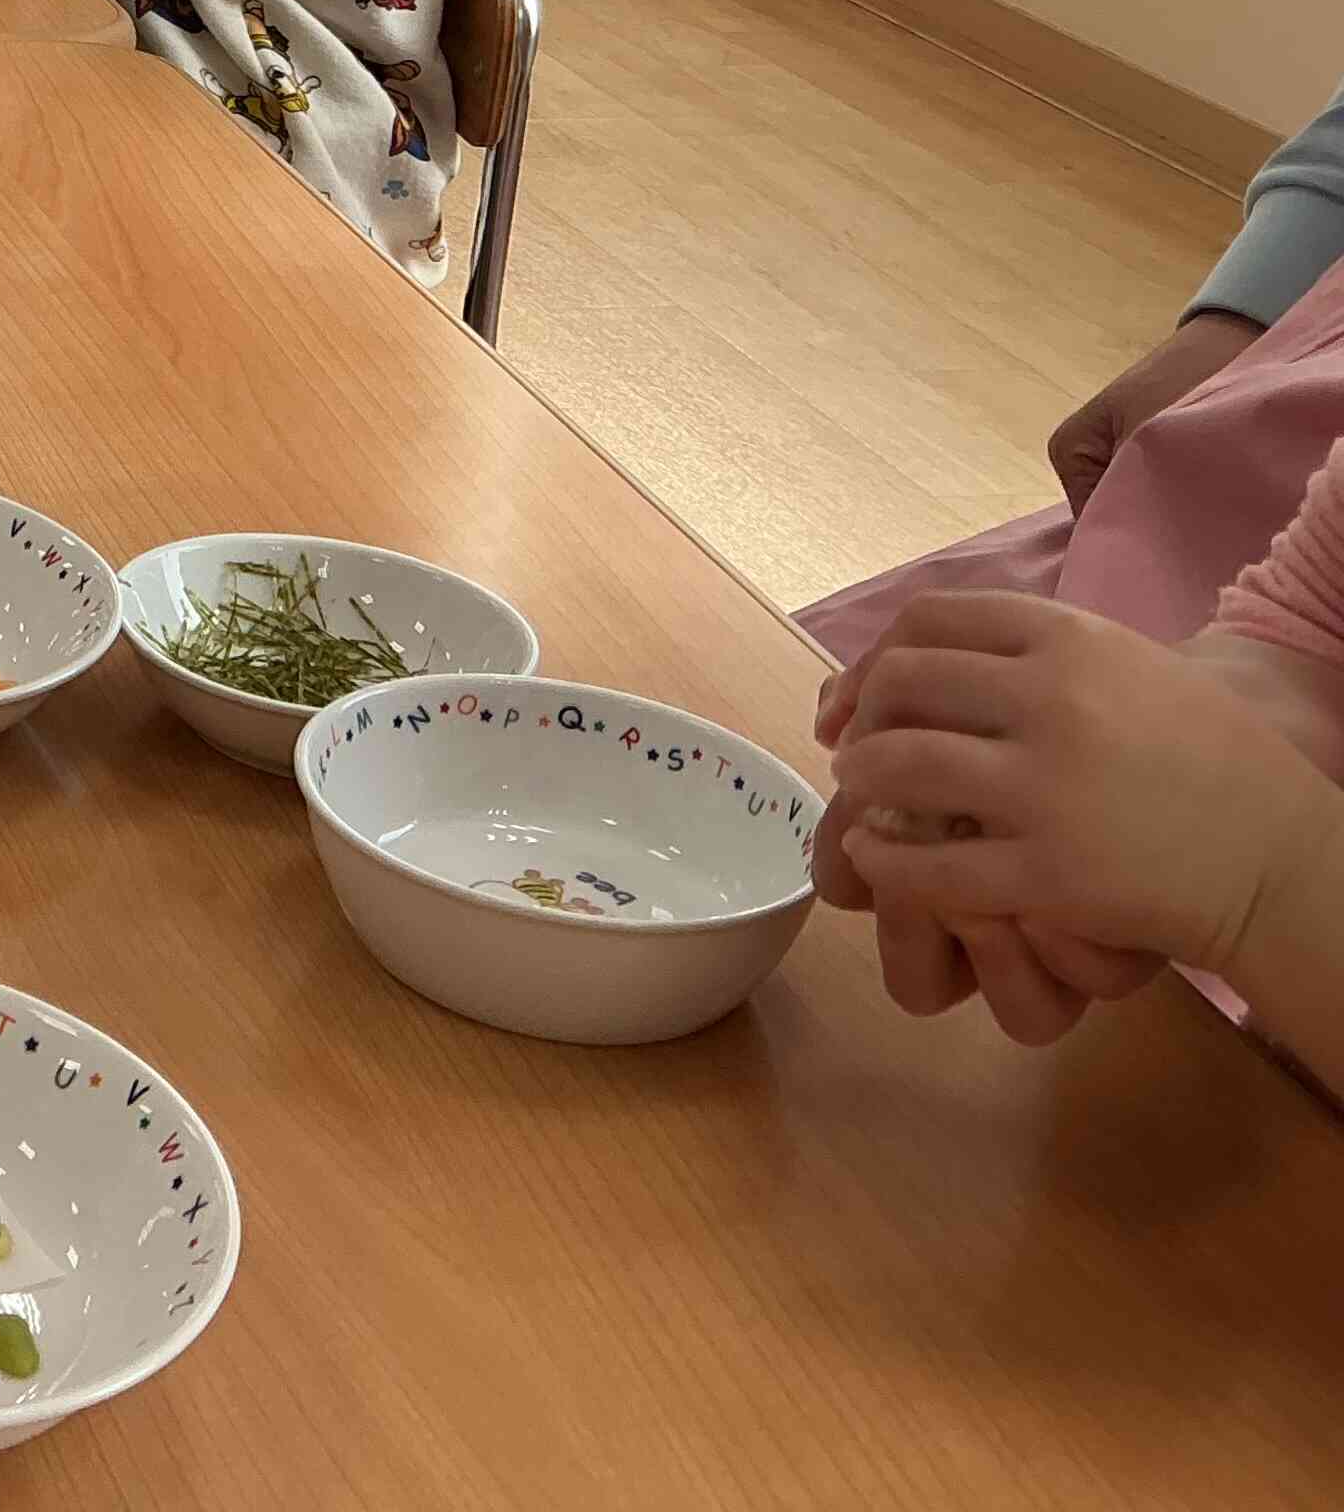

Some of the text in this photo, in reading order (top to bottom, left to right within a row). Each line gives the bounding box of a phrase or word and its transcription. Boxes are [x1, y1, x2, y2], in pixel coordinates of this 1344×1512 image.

[11, 518, 27, 538] V
[41, 545, 62, 567] W
[72, 573, 91, 593] X
[331, 724, 341, 745] L
[356, 707, 373, 734] M
[407, 705, 431, 733] N
[457, 695, 478, 715] O
[504, 707, 520, 728] P
[558, 706, 586, 732] Q
[619, 727, 640, 750] R
[668, 749, 684, 772] S
[716, 755, 732, 778] T
[747, 791, 765, 816] U
[789, 797, 802, 822] V
[576, 872, 637, 906] bee
[54, 1058, 77, 1089] U
[126, 1079, 151, 1106] V
[158, 1131, 184, 1164] W
[182, 1194, 208, 1223] X
